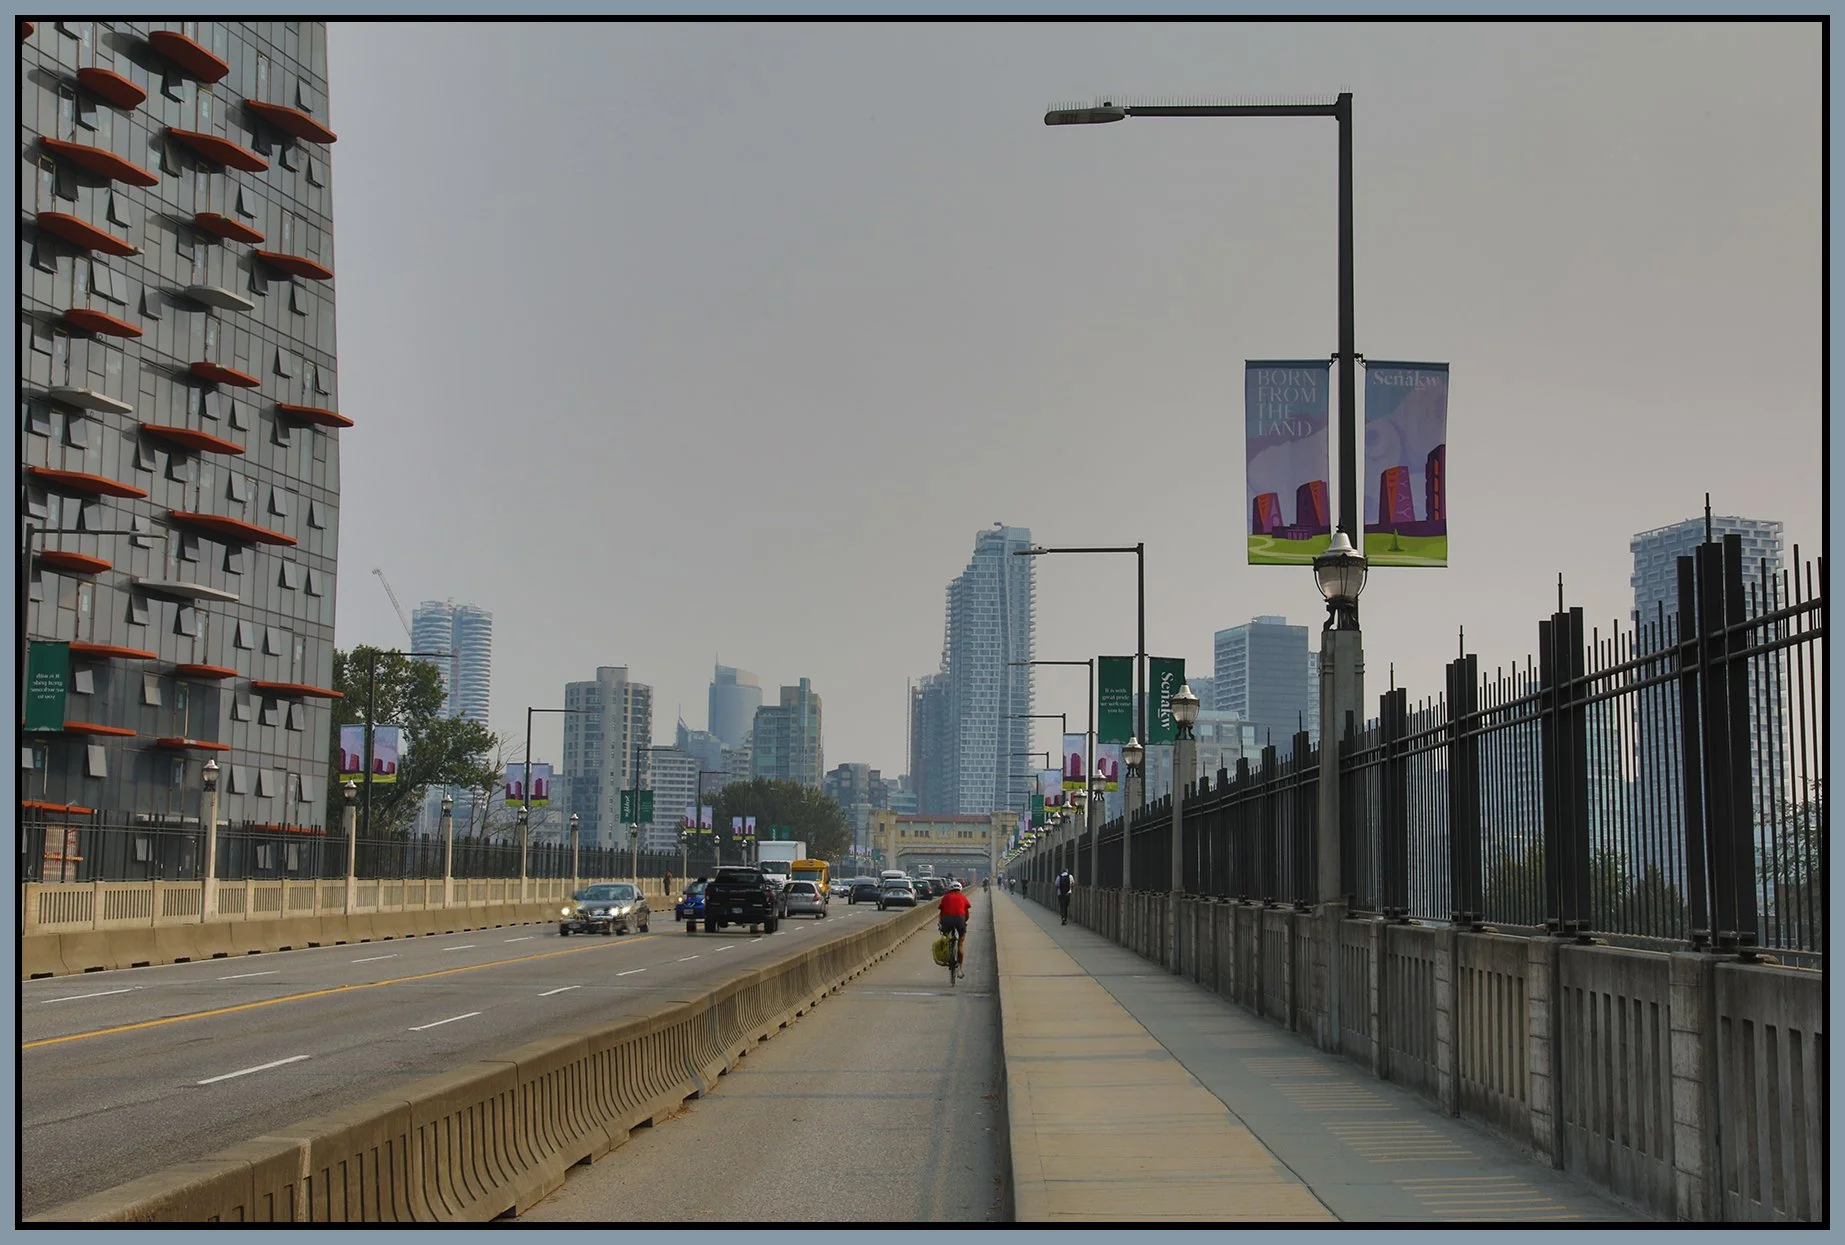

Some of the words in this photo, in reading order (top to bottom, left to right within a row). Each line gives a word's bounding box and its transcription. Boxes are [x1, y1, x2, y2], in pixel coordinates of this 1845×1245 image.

[1257, 368, 1317, 386] BORN
[1257, 386, 1317, 403] FROM
[1256, 403, 1297, 419] THE
[1257, 419, 1312, 437] LAND
